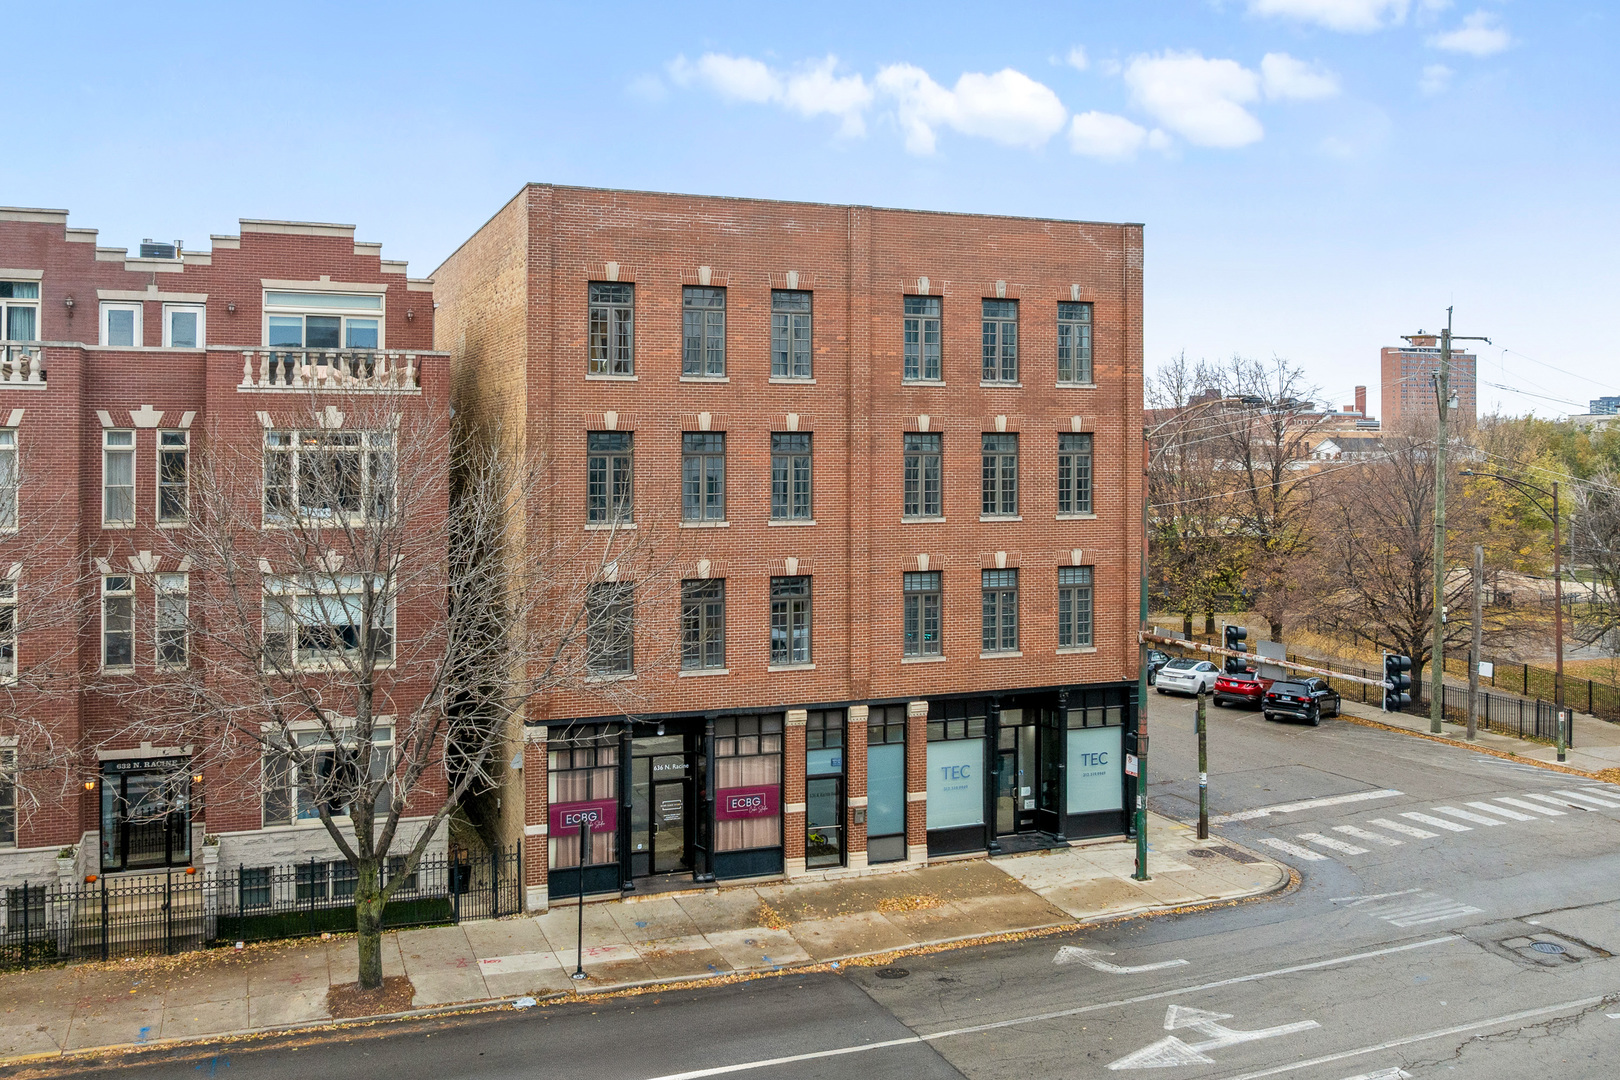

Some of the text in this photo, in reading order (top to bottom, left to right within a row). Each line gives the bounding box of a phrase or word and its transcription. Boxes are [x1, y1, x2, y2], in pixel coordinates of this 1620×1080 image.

[144, 760, 178, 768] RACINE
[1081, 751, 1108, 766] TEC
[941, 764, 970, 780] TEC
[731, 796, 761, 809] ECBG
[566, 812, 597, 825] ECBG
